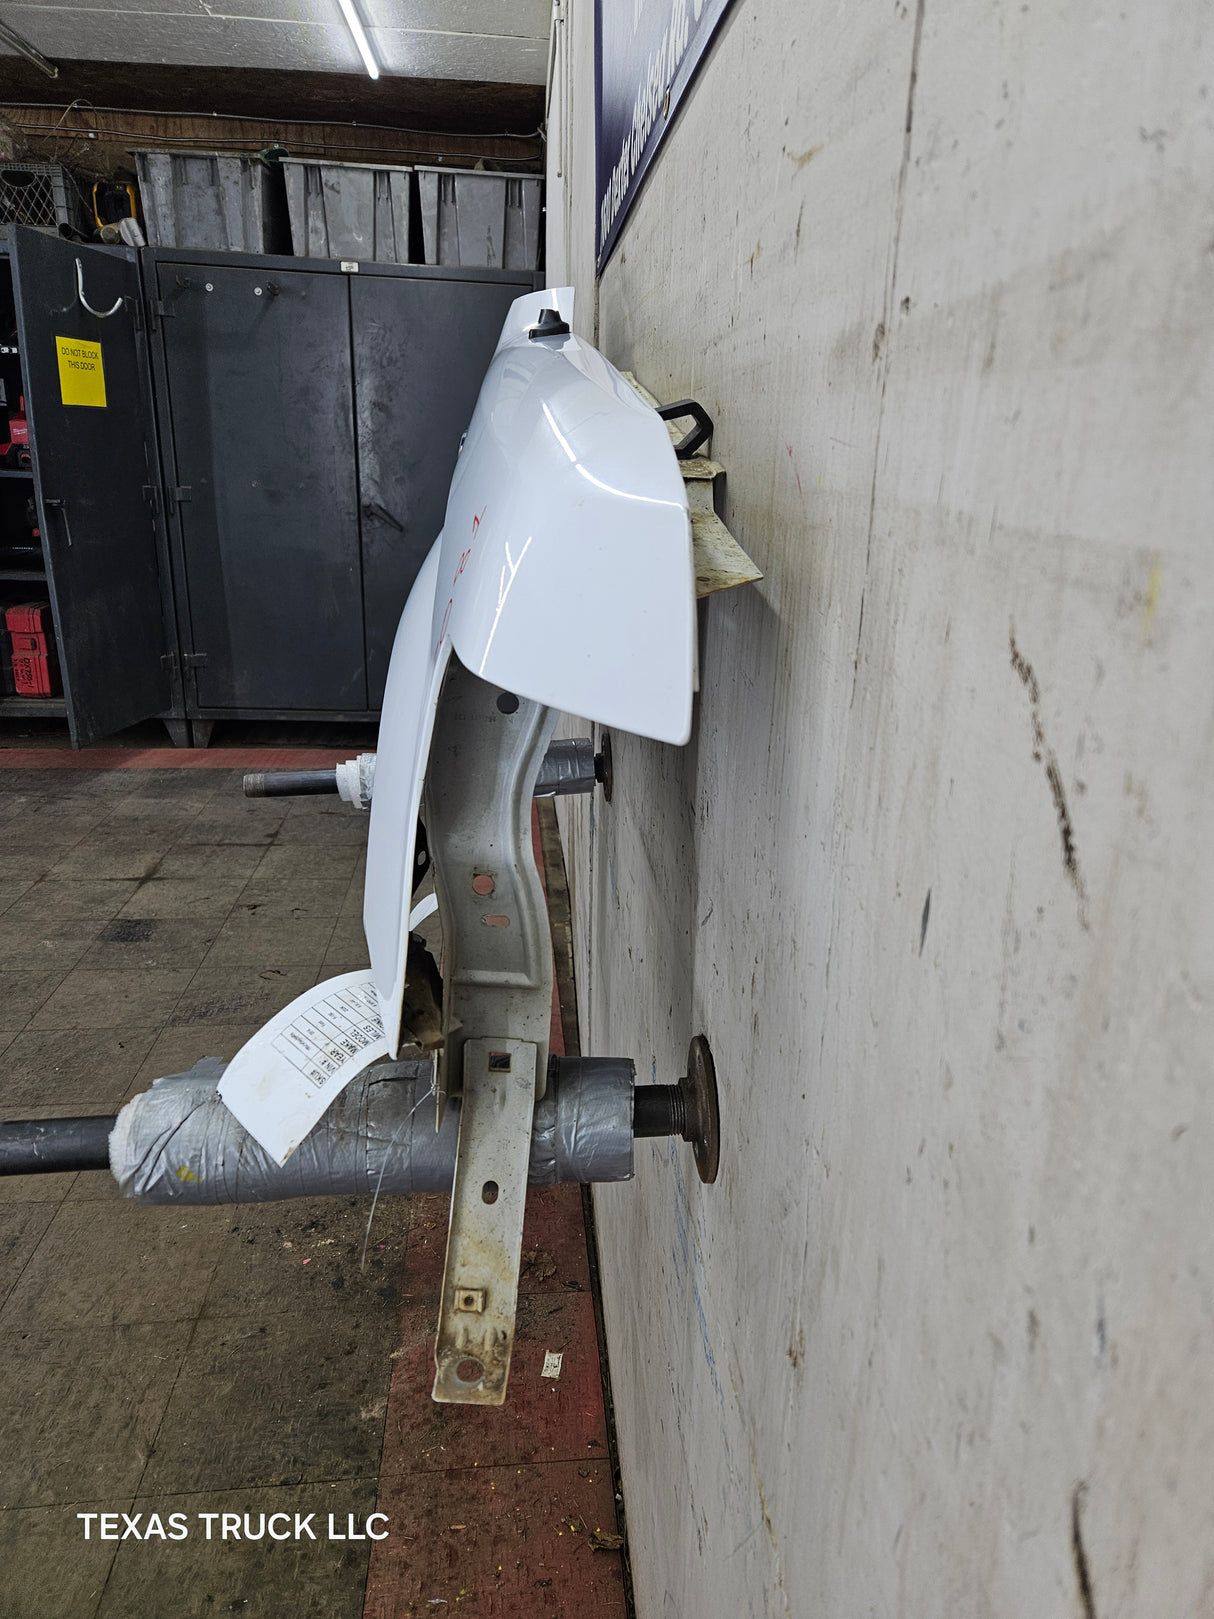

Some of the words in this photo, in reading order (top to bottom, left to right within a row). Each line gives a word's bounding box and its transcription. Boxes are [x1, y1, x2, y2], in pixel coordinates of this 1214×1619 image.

[61, 347, 70, 356] DO
[70, 349, 81, 357] NOT
[82, 350, 99, 360] BLOCK
[68, 360, 79, 370] THIS
[80, 361, 96, 371] DOOR
[350, 1029, 370, 1047] MODEL
[363, 1024, 382, 1040] MILES
[340, 1038, 358, 1055] MAKE
[329, 1047, 347, 1064] YEAR
[310, 1069, 327, 1085] SKU#
